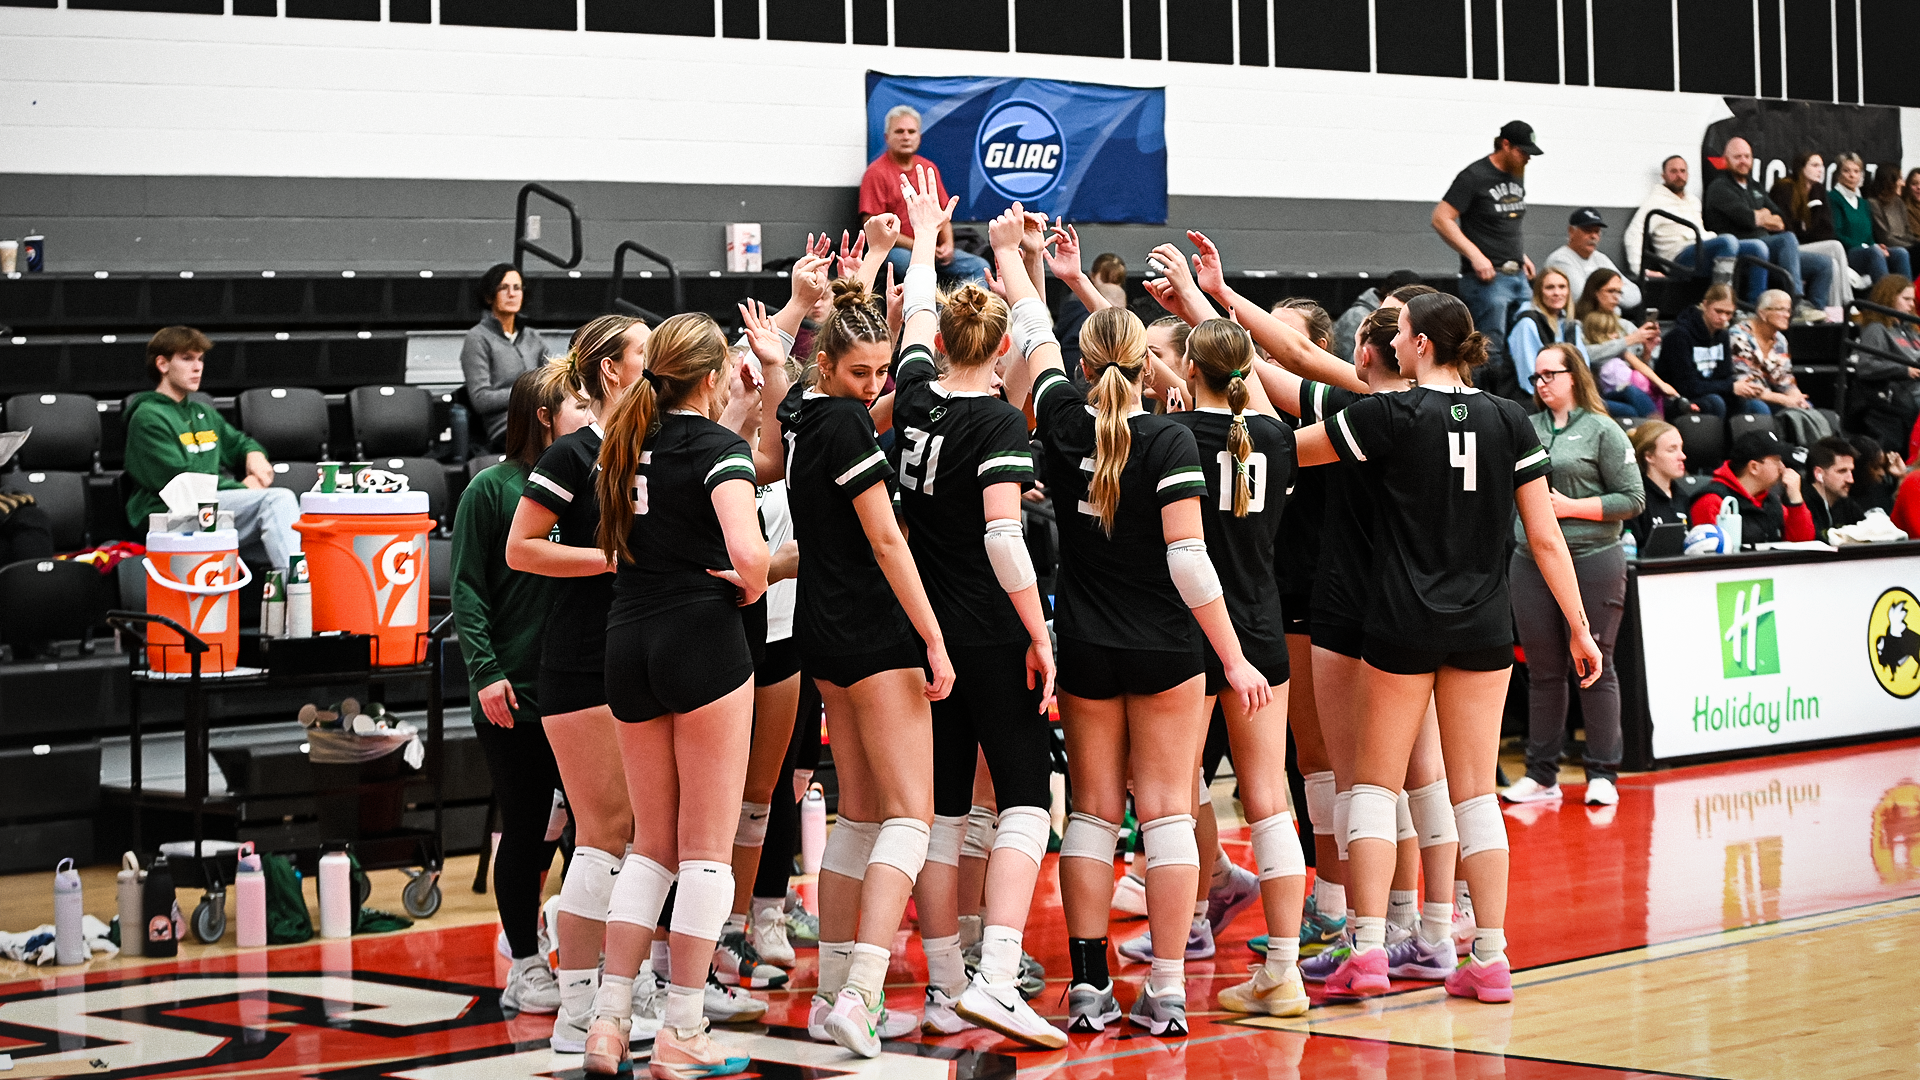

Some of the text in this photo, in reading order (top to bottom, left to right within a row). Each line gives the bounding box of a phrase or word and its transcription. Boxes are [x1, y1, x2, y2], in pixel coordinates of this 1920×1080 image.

[985, 143, 1060, 169] GLIAC
[900, 426, 944, 495] 21
[1217, 451, 1267, 513] 10
[1448, 431, 1476, 491] 4
[199, 506, 215, 527] G
[194, 561, 224, 587] G
[381, 540, 415, 585] G
[1692, 686, 1819, 733] Holiday Inn
